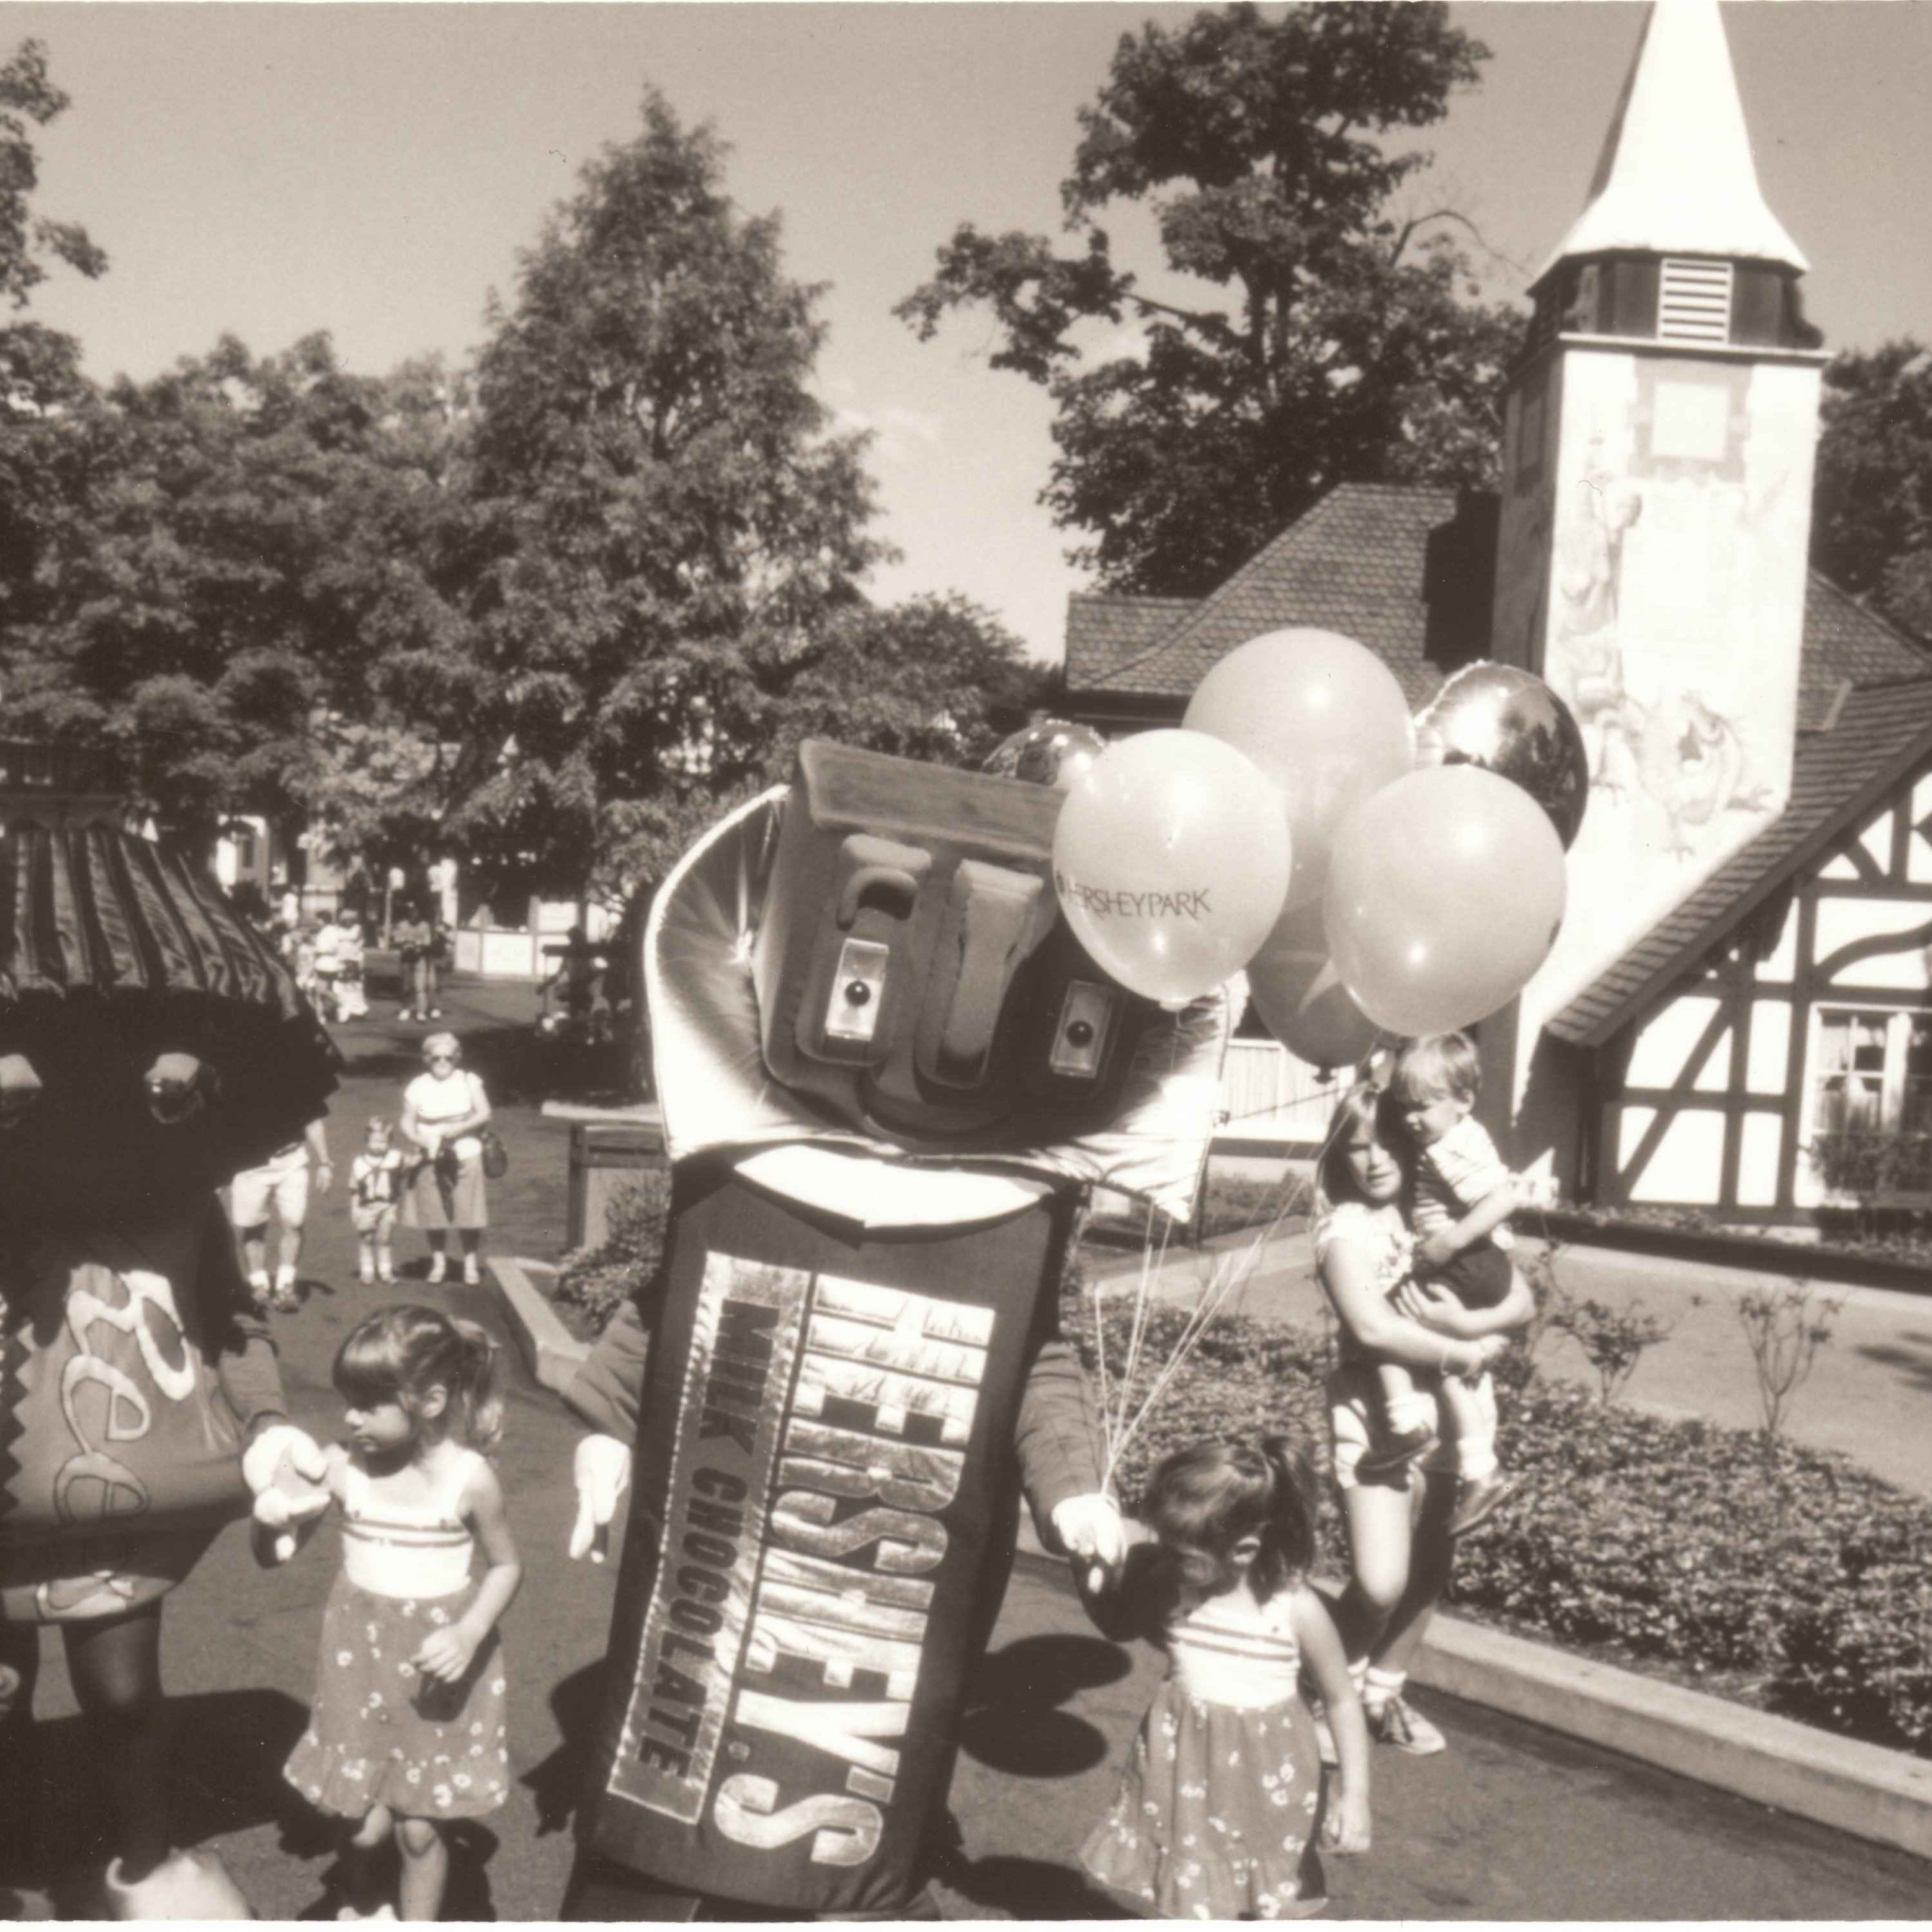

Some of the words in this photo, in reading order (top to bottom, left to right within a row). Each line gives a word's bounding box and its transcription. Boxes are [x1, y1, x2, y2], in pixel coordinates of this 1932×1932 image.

[699, 1298, 779, 1456] MILK
[639, 1467, 748, 1777] CHOCOLATE
[714, 1273, 995, 1866] HERSHEY'S
